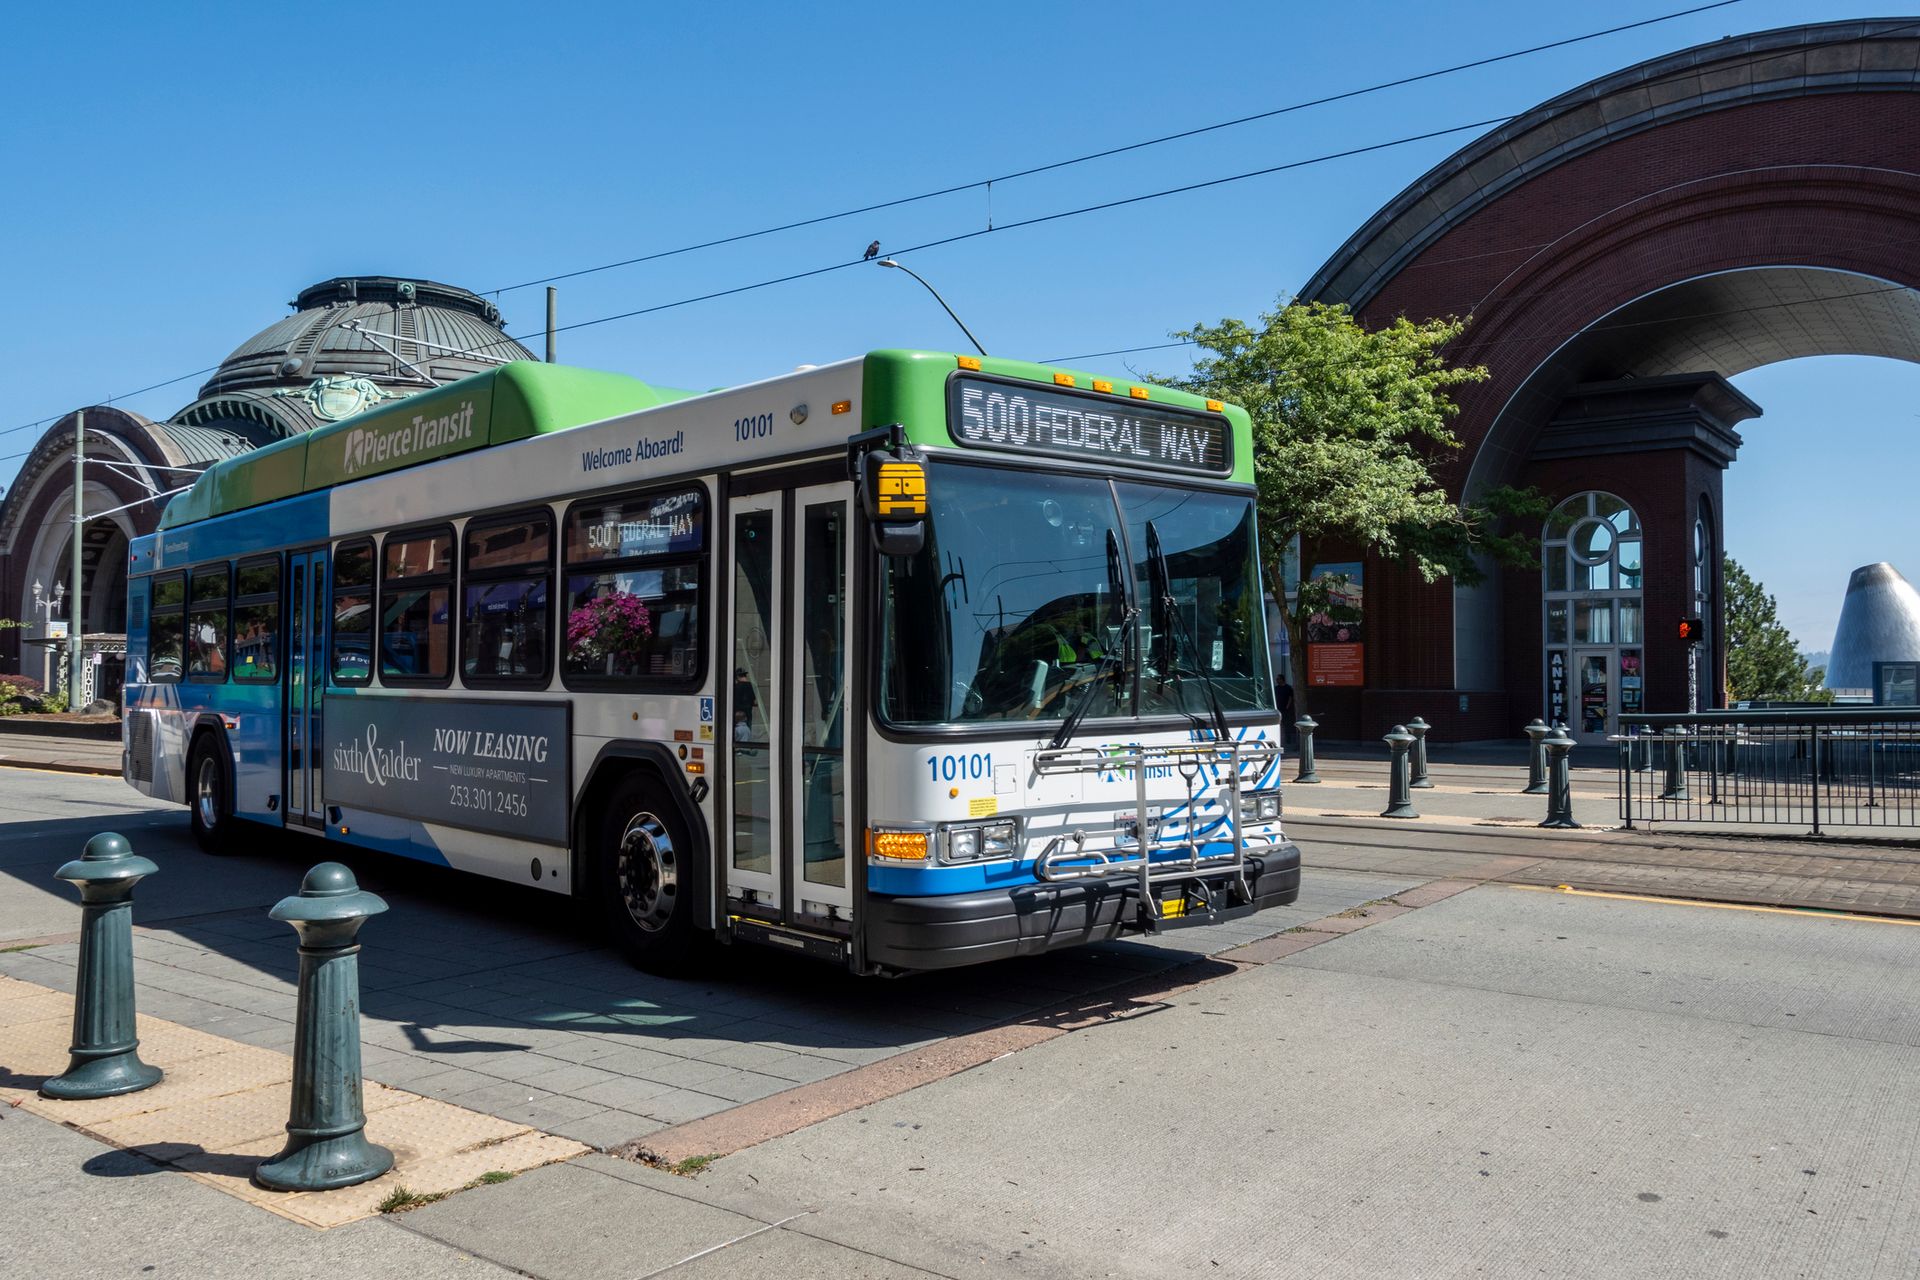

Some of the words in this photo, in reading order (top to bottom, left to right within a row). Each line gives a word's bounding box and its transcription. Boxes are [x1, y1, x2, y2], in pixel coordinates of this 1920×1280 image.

[734, 412, 773, 442] 10101
[963, 387, 1029, 445] 500
[1035, 405, 1150, 456] FEDERAL
[1161, 424, 1209, 463] WAY
[582, 447, 632, 471] Welcome
[635, 430, 684, 461] Aboard!
[588, 522, 612, 549] 500
[617, 517, 665, 543] FEDERAL
[669, 513, 693, 537] WAY
[433, 728, 471, 756] NOW
[473, 732, 548, 763] LEASING
[449, 764, 463, 775] NEW
[463, 766, 485, 779] LUXURY
[485, 769, 527, 784] APARTMENTS
[927, 752, 991, 782] 10101
[449, 784, 528, 817] 253.301.2456
